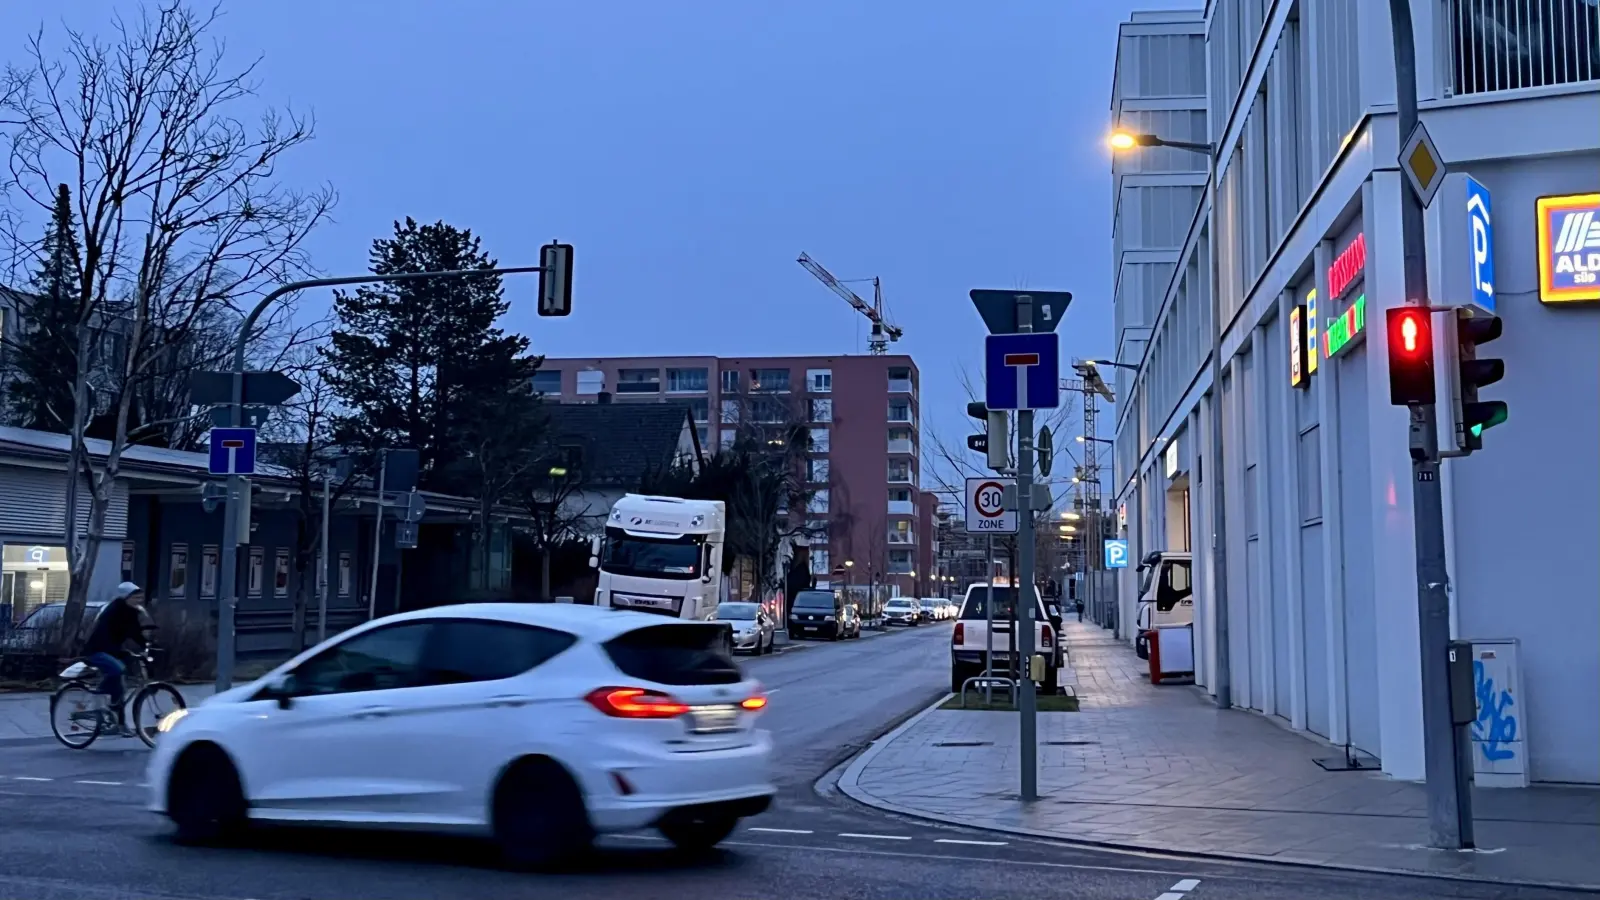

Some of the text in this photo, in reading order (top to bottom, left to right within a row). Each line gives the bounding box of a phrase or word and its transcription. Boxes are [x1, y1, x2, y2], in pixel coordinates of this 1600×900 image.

[1473, 214, 1488, 290] P
[1555, 253, 1600, 273] ALD
[981, 491, 1001, 507] 30
[978, 520, 1004, 529] ZONE
[1110, 548, 1123, 564] P
